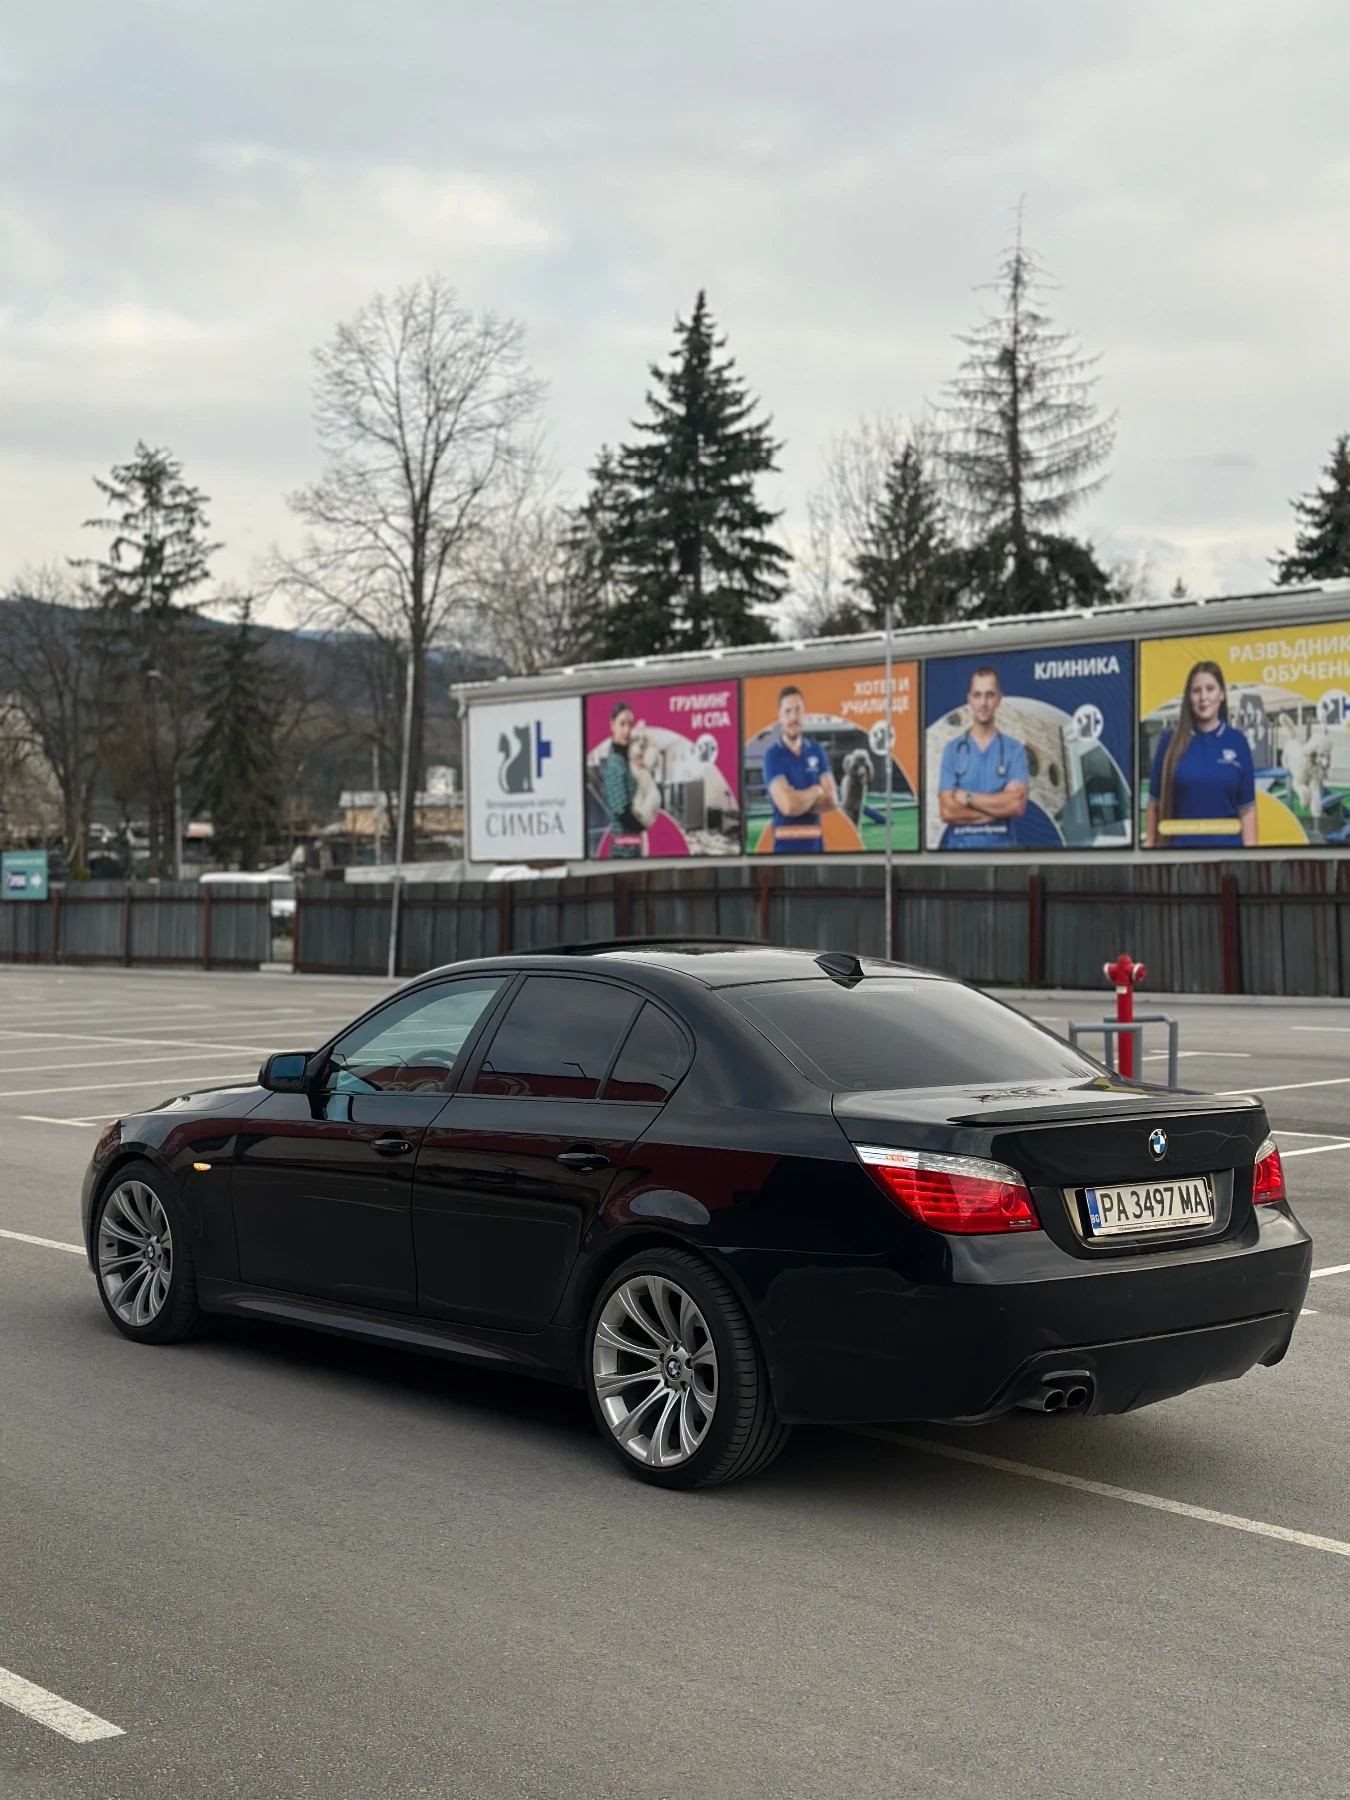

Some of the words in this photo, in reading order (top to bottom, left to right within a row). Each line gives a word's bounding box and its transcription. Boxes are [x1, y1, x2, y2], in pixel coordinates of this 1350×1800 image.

[1034, 655, 1120, 680] КЛИНИКА
[703, 710, 731, 729] СПА
[486, 811, 565, 838] СИМБА
[1099, 1191, 1130, 1223] PA
[1130, 1186, 1174, 1219] 3497
[1178, 1184, 1206, 1215] MA
